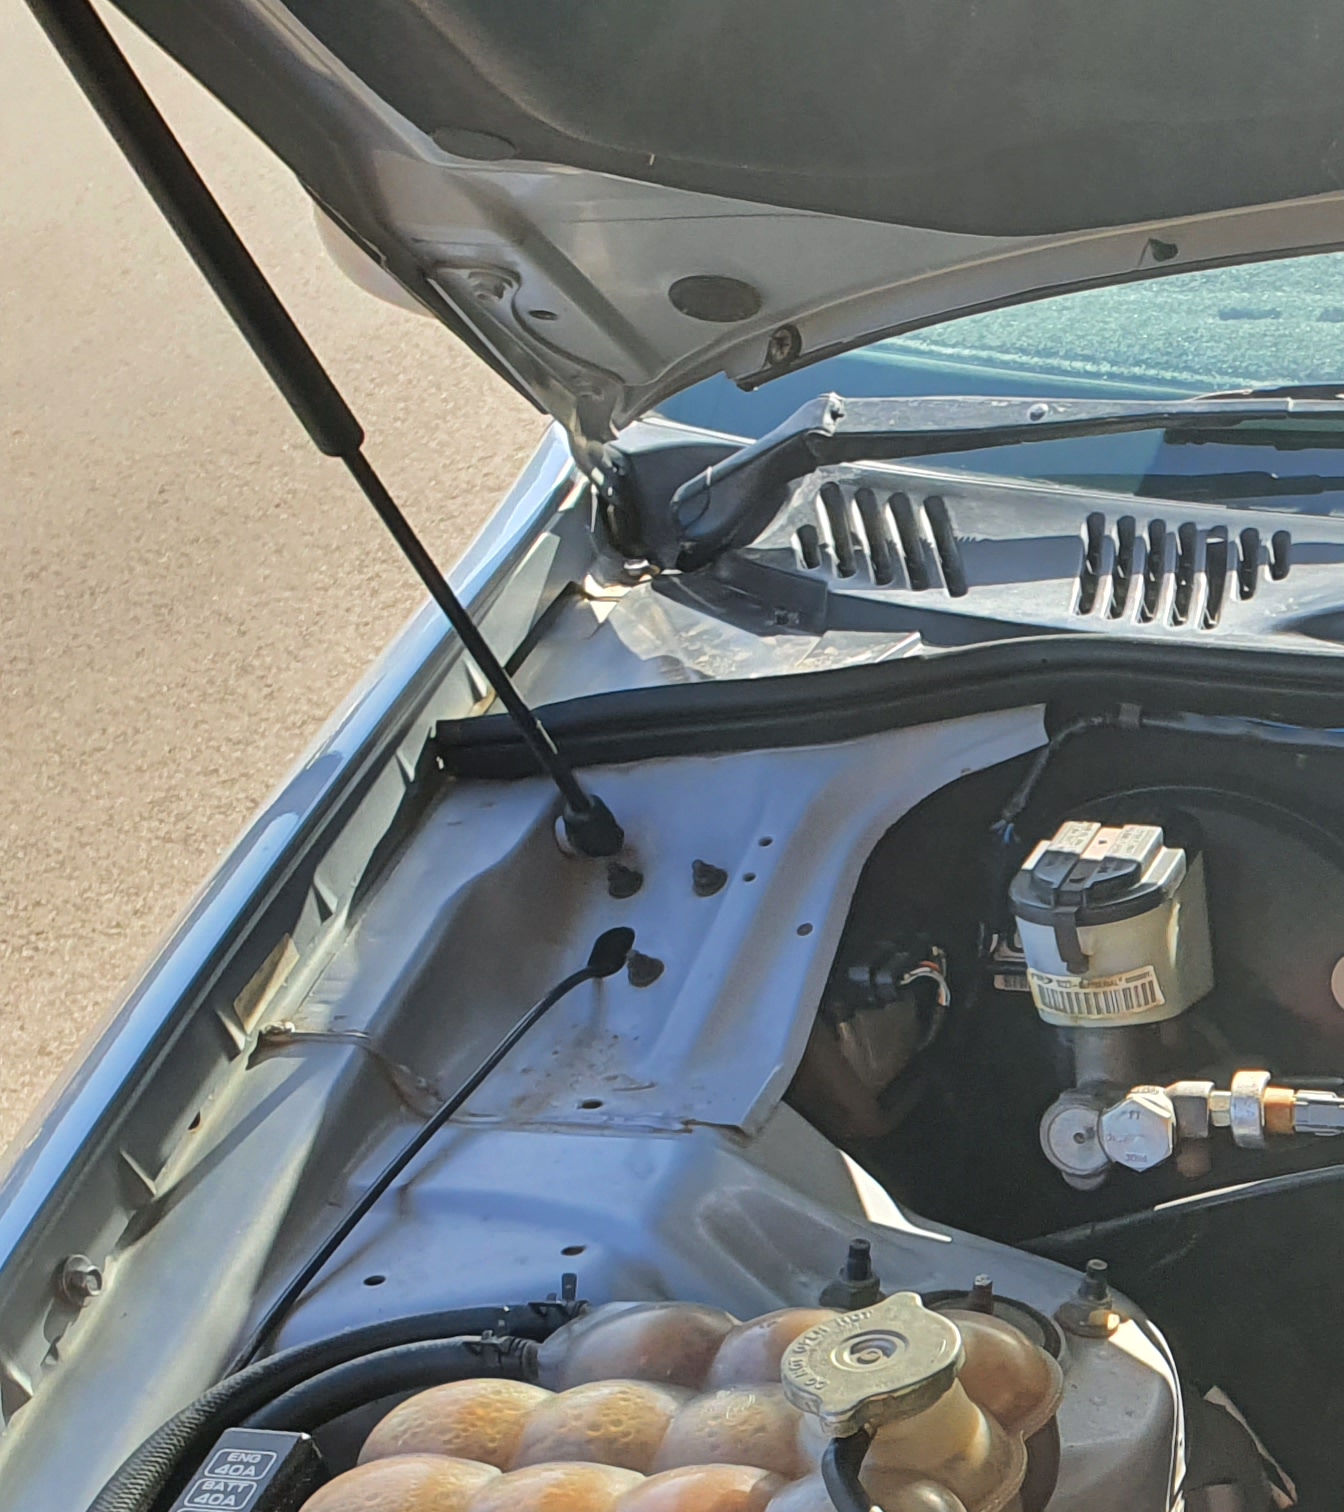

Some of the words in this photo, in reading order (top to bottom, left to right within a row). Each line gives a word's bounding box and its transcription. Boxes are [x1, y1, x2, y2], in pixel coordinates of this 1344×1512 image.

[227, 1452, 262, 1464] ENG
[214, 1464, 256, 1477] 40A
[201, 1480, 249, 1493] BATT
[193, 1493, 236, 1507] 40A
